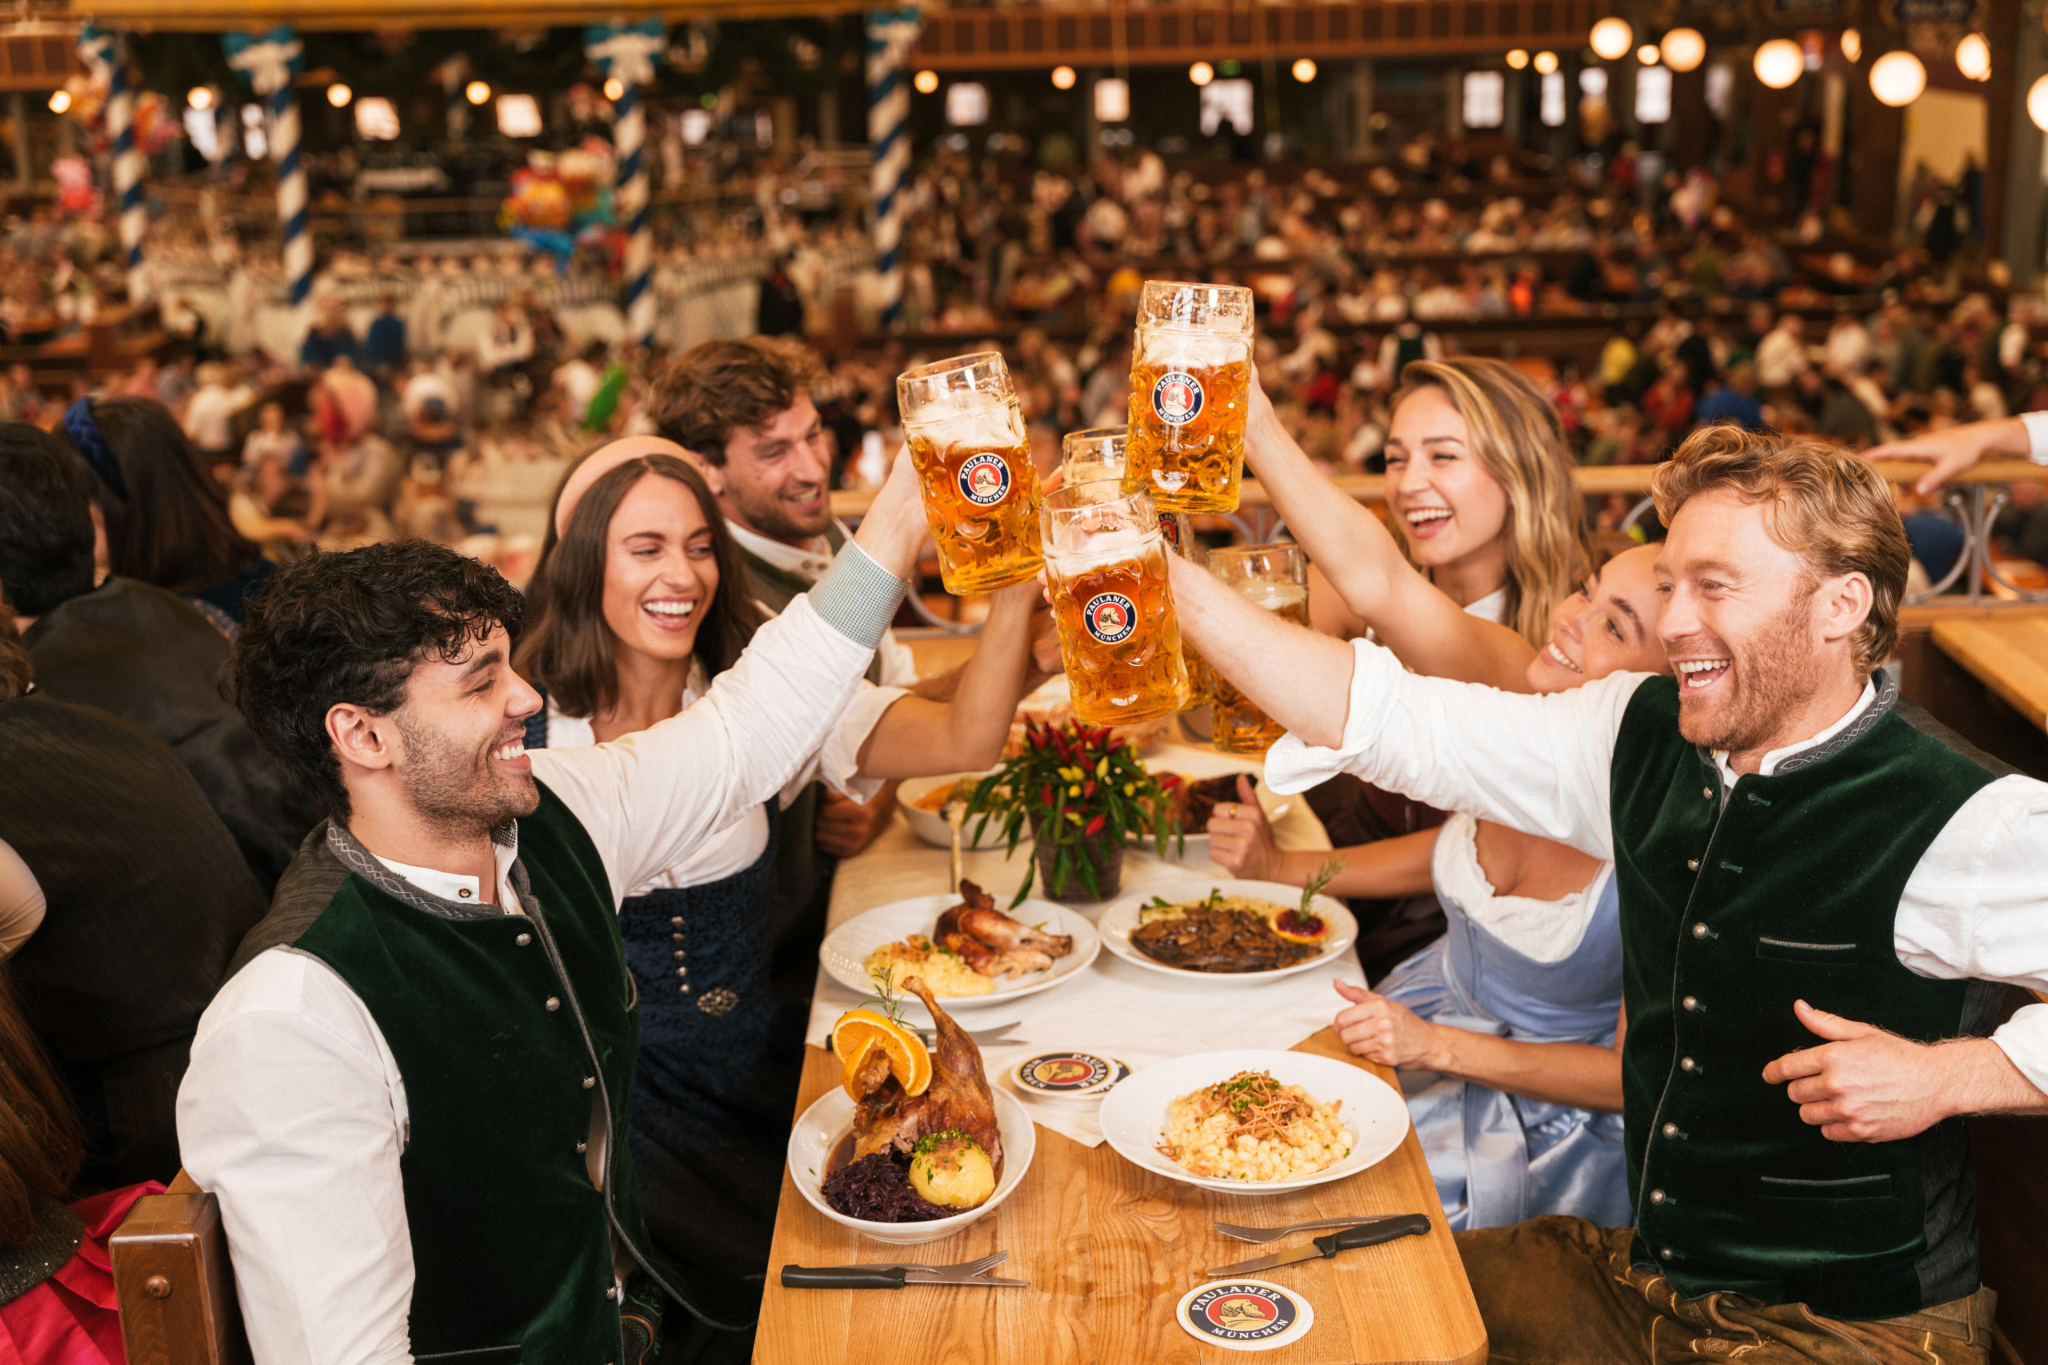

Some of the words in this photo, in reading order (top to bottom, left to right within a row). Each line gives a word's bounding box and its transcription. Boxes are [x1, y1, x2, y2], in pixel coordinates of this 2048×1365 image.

[1156, 375, 1200, 394] PAULANER
[961, 456, 1003, 480] PAULANER
[1086, 595, 1131, 616] PAULANER
[1192, 1285, 1281, 1311] PAULANER
[1211, 1319, 1289, 1339] MÜNCHEN
